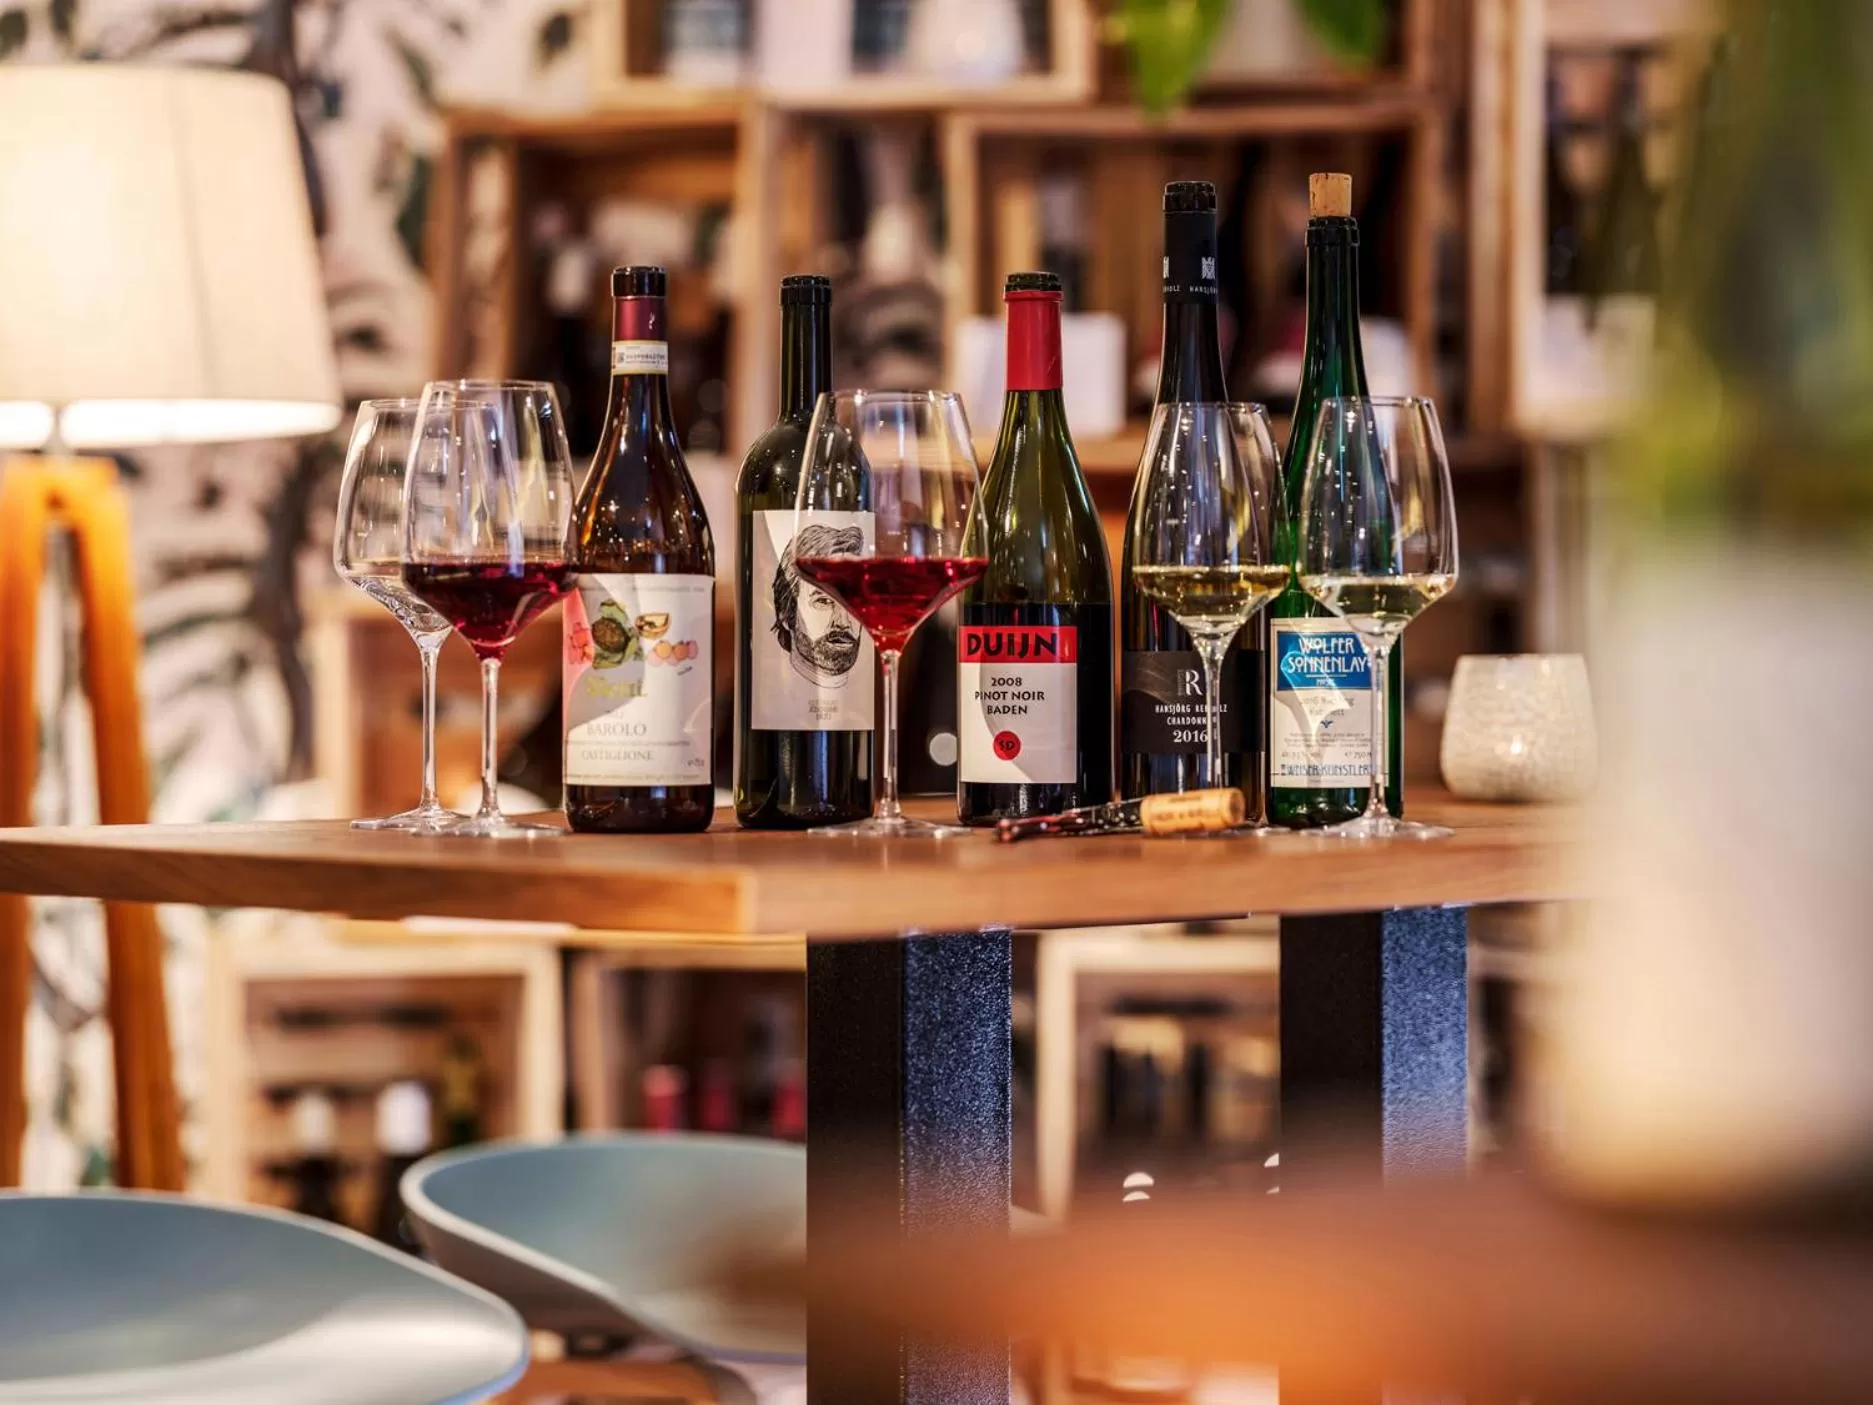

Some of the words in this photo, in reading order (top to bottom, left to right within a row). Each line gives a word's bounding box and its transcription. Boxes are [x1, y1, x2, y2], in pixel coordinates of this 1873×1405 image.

[967, 632, 1058, 658] DUIJN
[1299, 637, 1355, 654] WOLFER
[1287, 656, 1367, 673] SONNENLAY
[991, 677, 1023, 687] 2008
[974, 691, 1009, 701] PINOT
[1011, 691, 1045, 701] NOIR
[987, 705, 1028, 715] BADEN
[1155, 703, 1191, 715] HANSJÖRG
[1167, 716, 1217, 726] CHARDONNY
[587, 723, 648, 737] BAROLO
[1173, 729, 1209, 743] 2016
[582, 749, 654, 761] CASTIGLIONE
